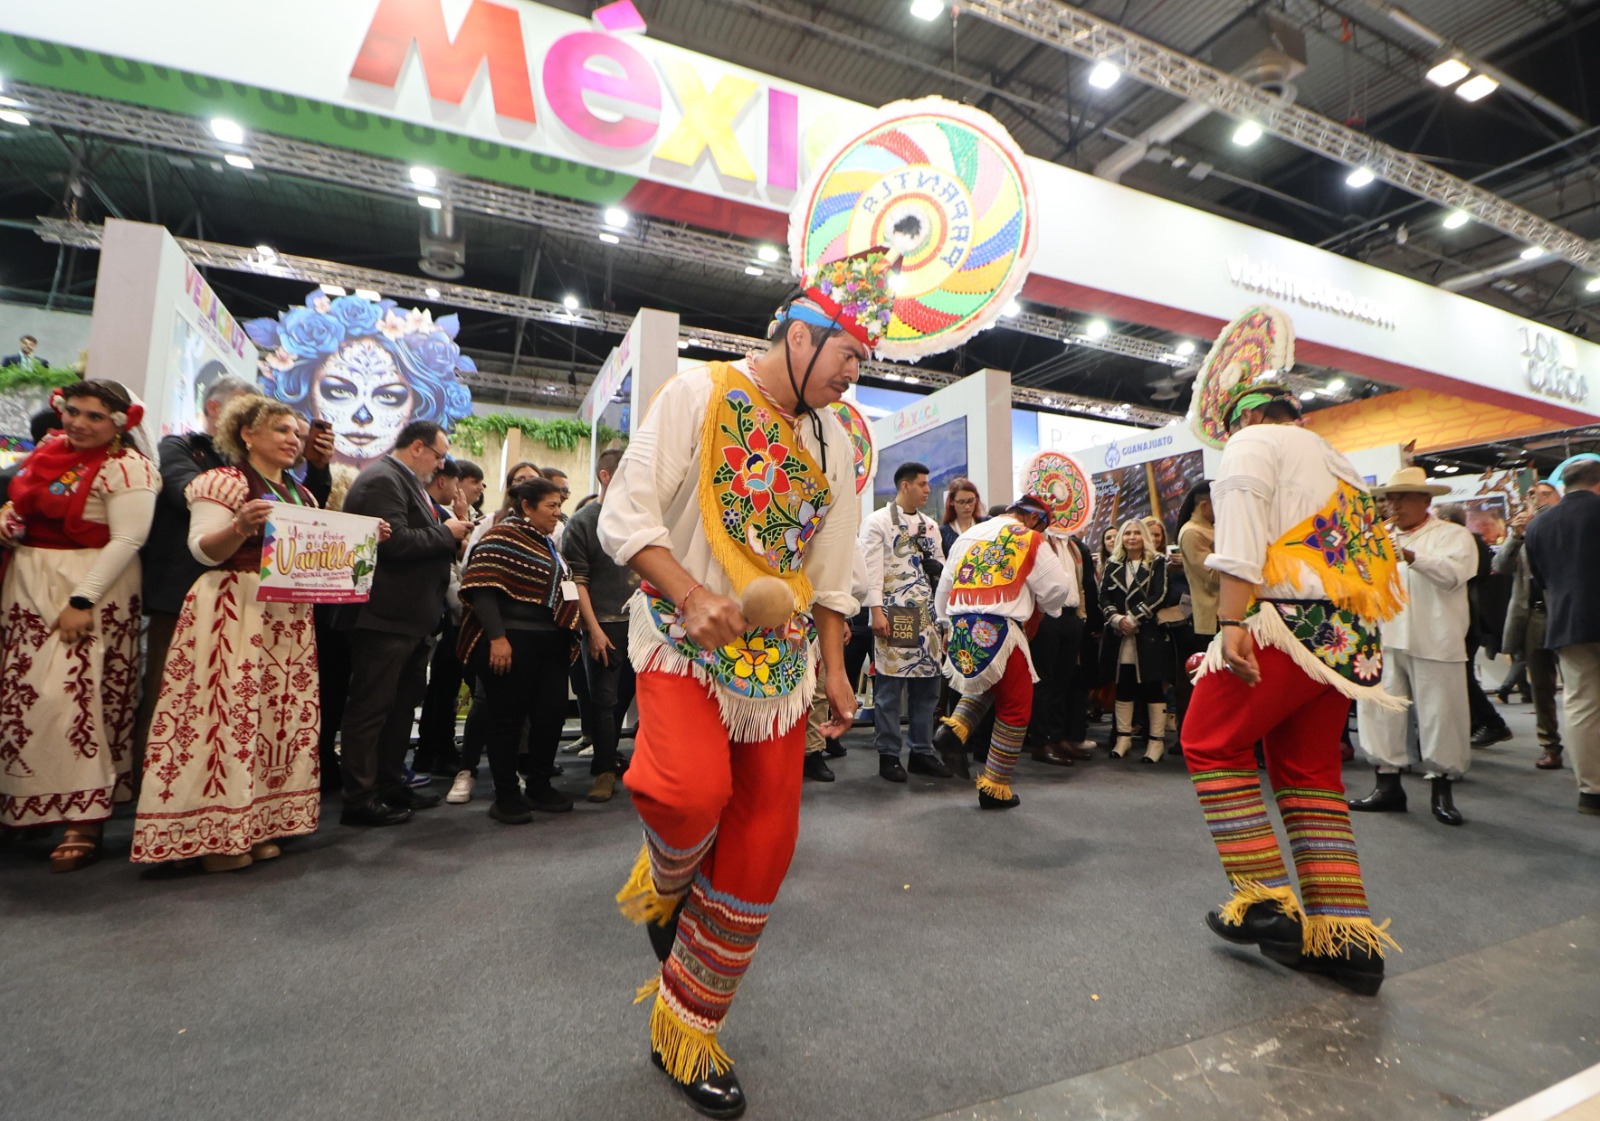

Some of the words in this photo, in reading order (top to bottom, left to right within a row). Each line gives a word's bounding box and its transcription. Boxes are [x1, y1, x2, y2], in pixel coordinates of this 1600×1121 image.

[185, 257, 245, 359] VERACRUZ
[1226, 253, 1399, 329] visitmexico.com
[1122, 435, 1173, 455] GUANAJUATO
